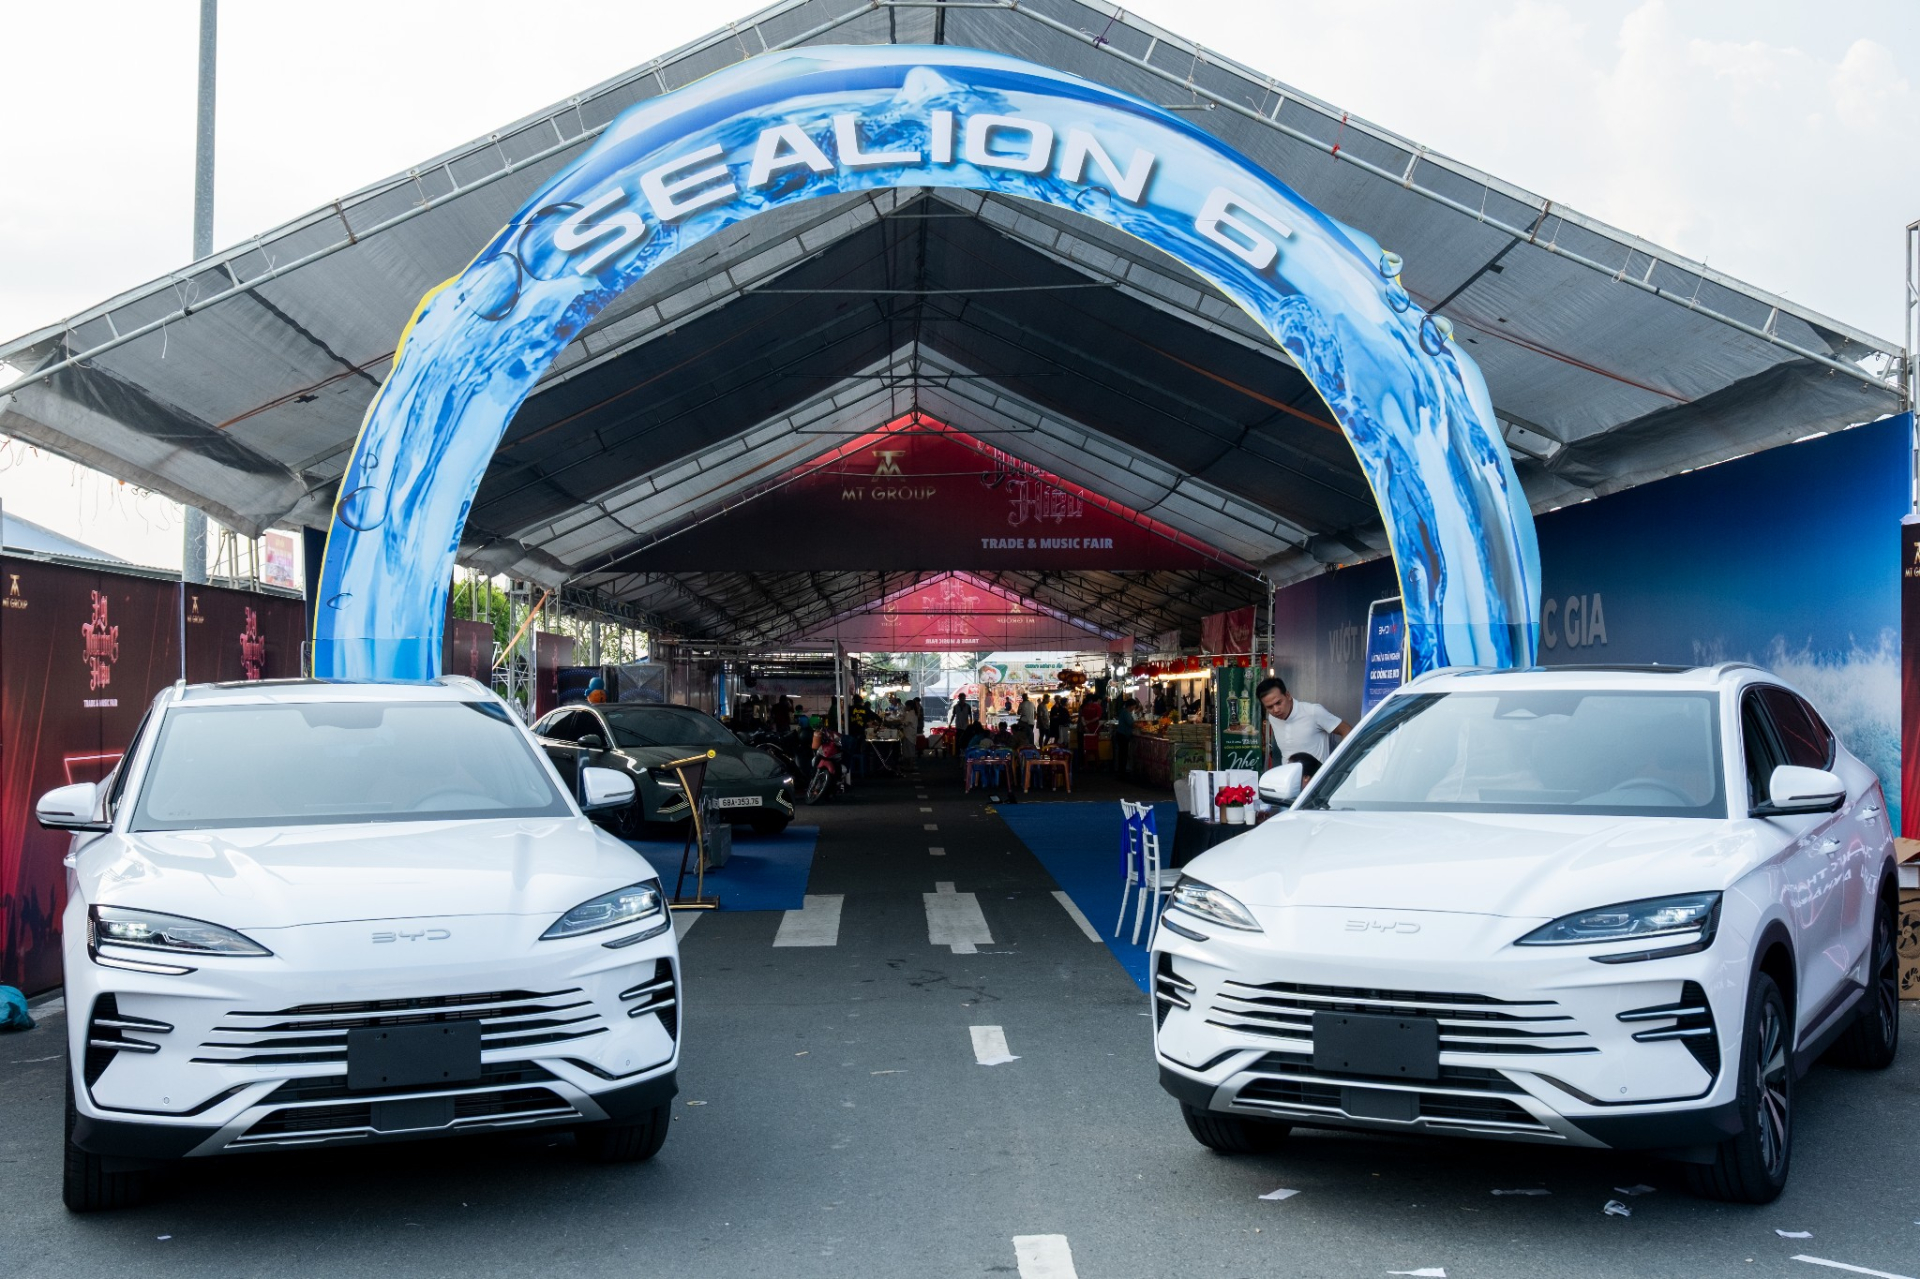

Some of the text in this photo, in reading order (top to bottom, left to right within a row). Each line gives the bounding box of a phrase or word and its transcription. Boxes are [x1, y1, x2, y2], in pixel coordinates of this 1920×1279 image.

[553, 110, 1293, 276] SEALION 6
[842, 486, 937, 501] MT GROUP
[981, 538, 1114, 549] TRADE & MUSIC FAIR
[1564, 592, 1608, 648] GIA
[1378, 625, 1390, 635] BYD
[1344, 920, 1421, 934] BYD
[371, 928, 451, 944] BYD
